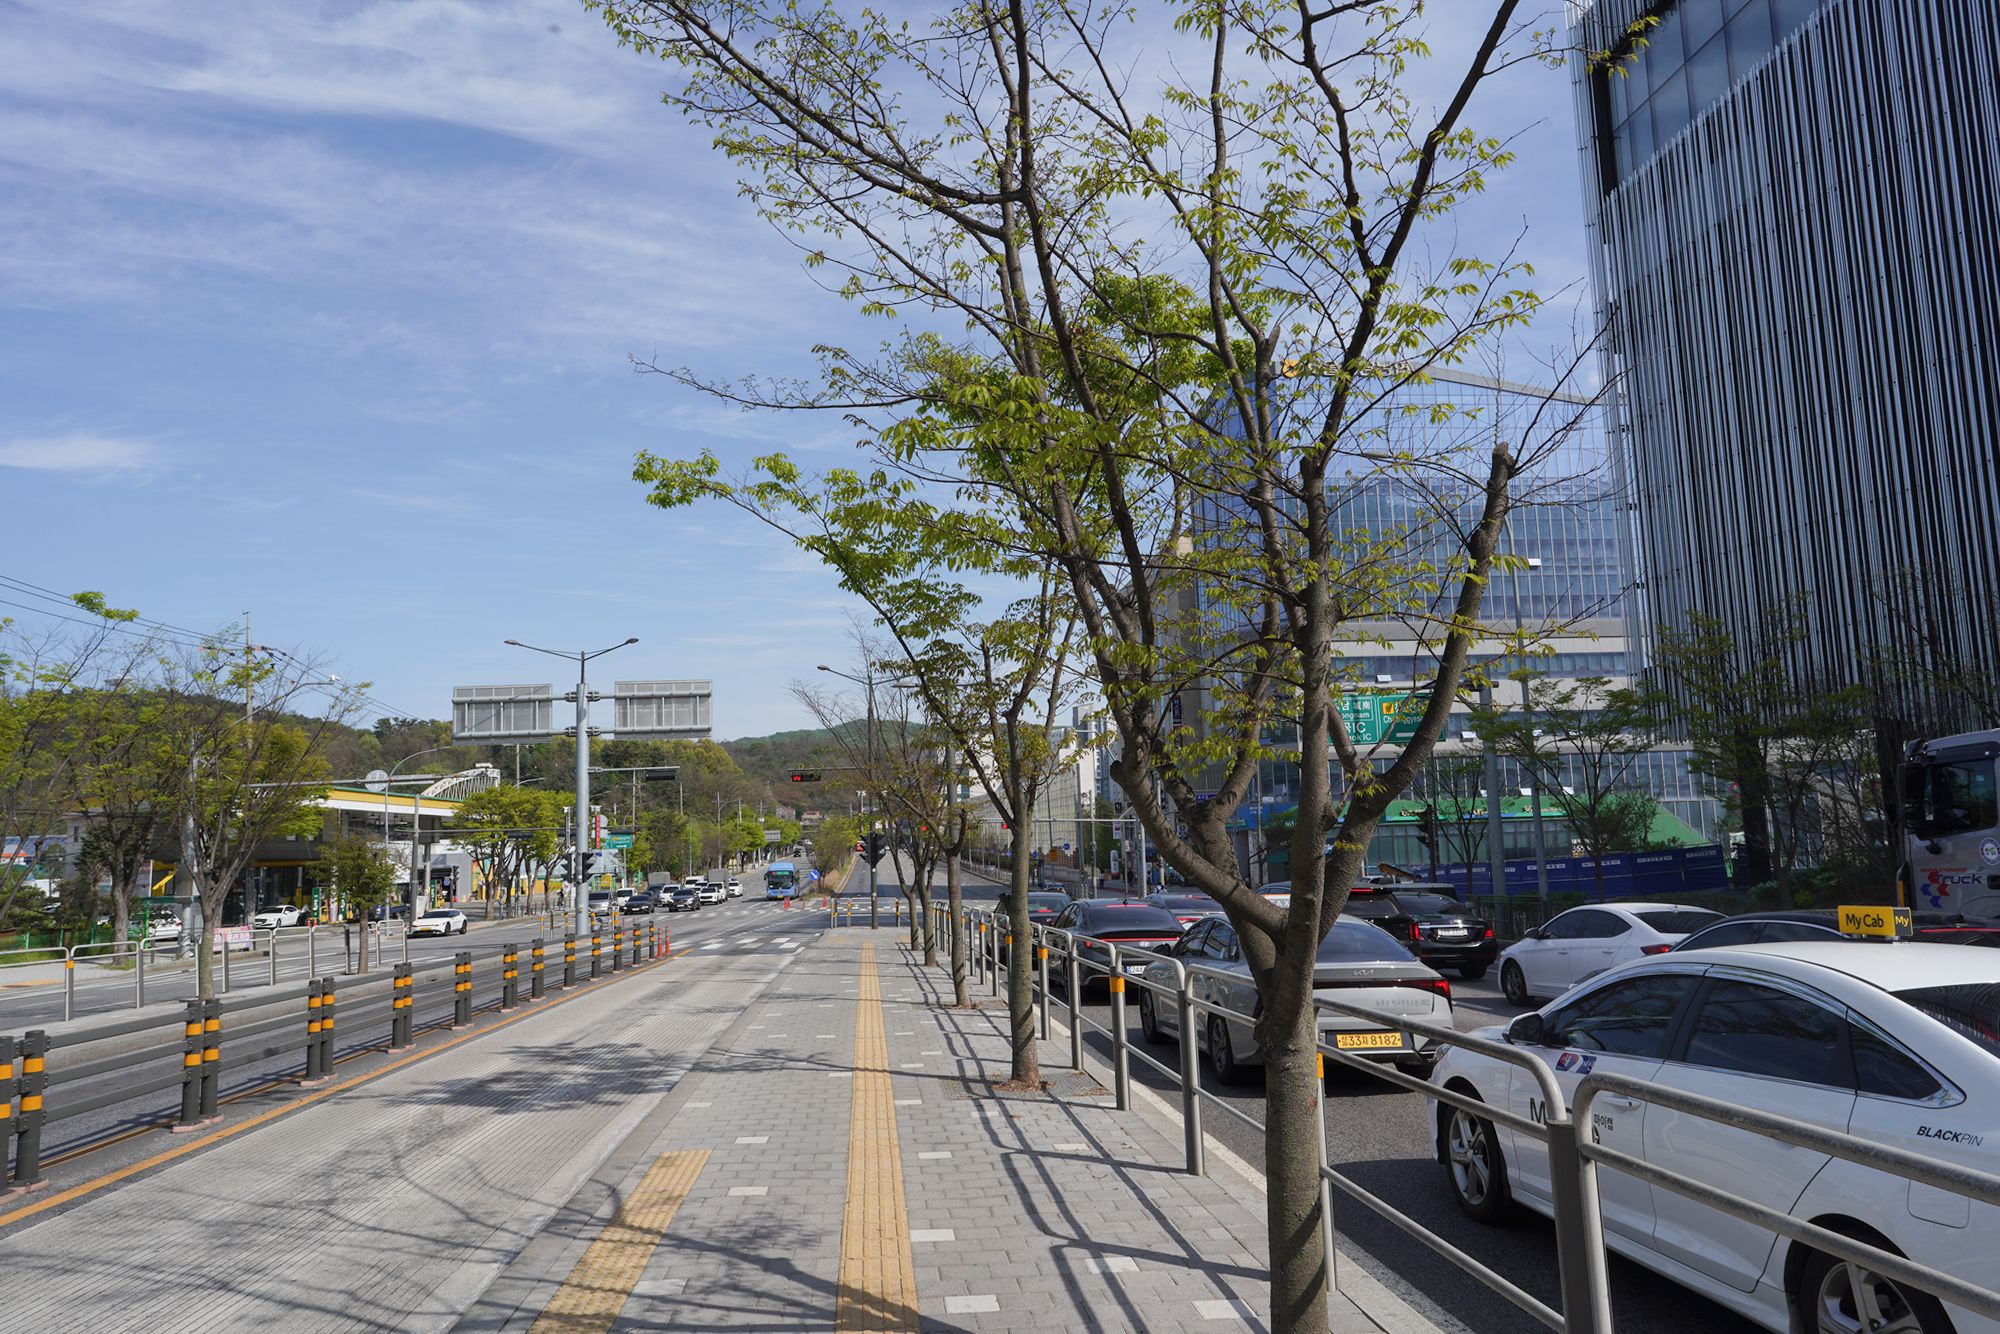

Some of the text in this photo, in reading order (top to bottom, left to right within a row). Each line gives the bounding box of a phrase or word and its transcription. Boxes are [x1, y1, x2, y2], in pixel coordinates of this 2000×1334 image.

[1845, 913, 1885, 930] My Cab
[1370, 1034, 1398, 1046] 8182
[1916, 1125, 1984, 1147] BLACKPIN
